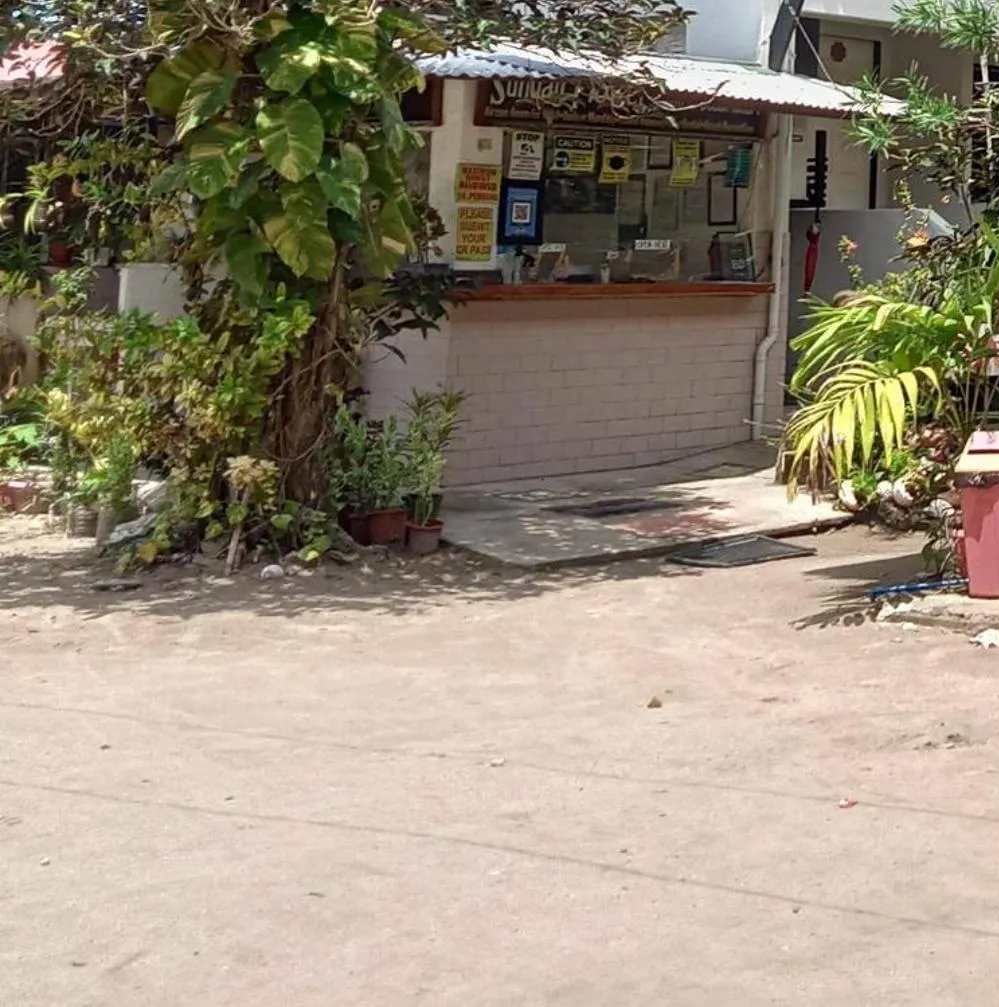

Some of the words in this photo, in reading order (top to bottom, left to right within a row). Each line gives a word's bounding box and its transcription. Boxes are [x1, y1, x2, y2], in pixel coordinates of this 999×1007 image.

[516, 133, 540, 141] STOP
[558, 139, 592, 148] CAUTION
[459, 207, 492, 219] PLEASE
[462, 233, 486, 244] YOUR
[470, 245, 491, 255] PASS
